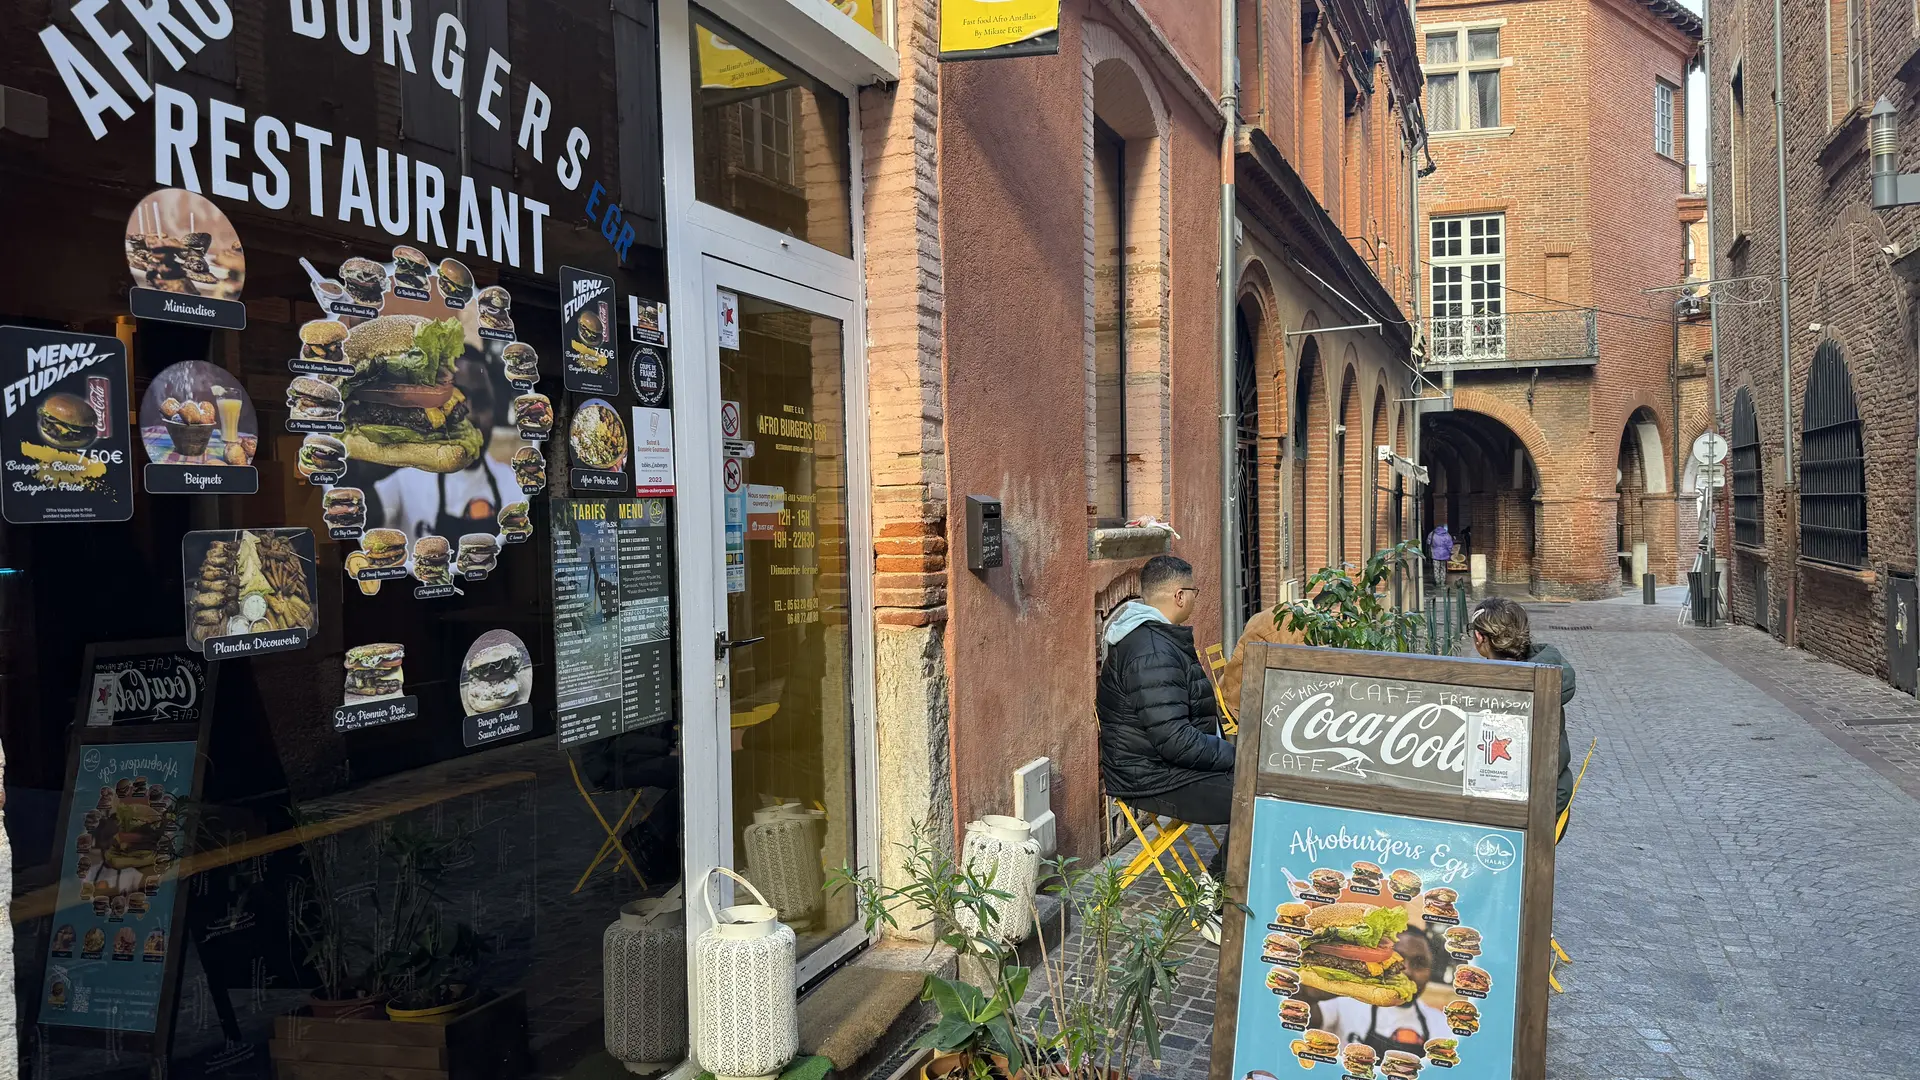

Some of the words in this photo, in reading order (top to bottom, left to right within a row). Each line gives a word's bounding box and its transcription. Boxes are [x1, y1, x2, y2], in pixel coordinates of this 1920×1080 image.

[977, 16, 991, 25] food
[1009, 13, 1036, 22] Antillais
[974, 30, 982, 38] By
[984, 28, 1006, 36] Mikate
[155, 82, 550, 274] RESTAURANT
[585, 180, 635, 262] EGR
[573, 280, 602, 297] MENU
[163, 299, 216, 318] Miniardises
[564, 287, 610, 324] ETUDIANT
[26, 343, 96, 374] MENU
[594, 347, 614, 360] 7,50€
[640, 370, 657, 378] FRANCE
[3, 352, 115, 418] ETUDIANT
[641, 380, 657, 388] BURGER
[760, 415, 779, 436] AFRO
[780, 418, 813, 440] BURGERS
[814, 424, 827, 442] EGR
[77, 450, 123, 465] 7,50€
[5, 460, 40, 475] Burger
[52, 461, 86, 472] Boisson
[13, 481, 47, 496] Burger
[59, 481, 85, 492] Frites
[184, 472, 223, 490] Beignets
[581, 475, 592, 487] Afro
[593, 476, 606, 485] Poke
[572, 504, 606, 520] TARIFS
[619, 504, 643, 519] MENU
[778, 509, 790, 526] 12H
[797, 510, 810, 526] 15H
[773, 531, 787, 548] 19H
[793, 532, 814, 548] 22H30
[770, 565, 800, 575] Dimanche
[802, 564, 818, 574] fermé
[213, 640, 252, 654] Plancha
[253, 634, 300, 649] Découverte
[1350, 682, 1423, 704] CAFE
[357, 709, 388, 720] Pionnier
[1264, 688, 1296, 727] FRITE
[477, 718, 498, 729] Burger
[499, 710, 518, 722] Poulet
[478, 730, 497, 740] Sauce
[1268, 752, 1325, 772] CAFE
[1290, 826, 1426, 864] Afroburgers
[1430, 844, 1475, 883] Egr
